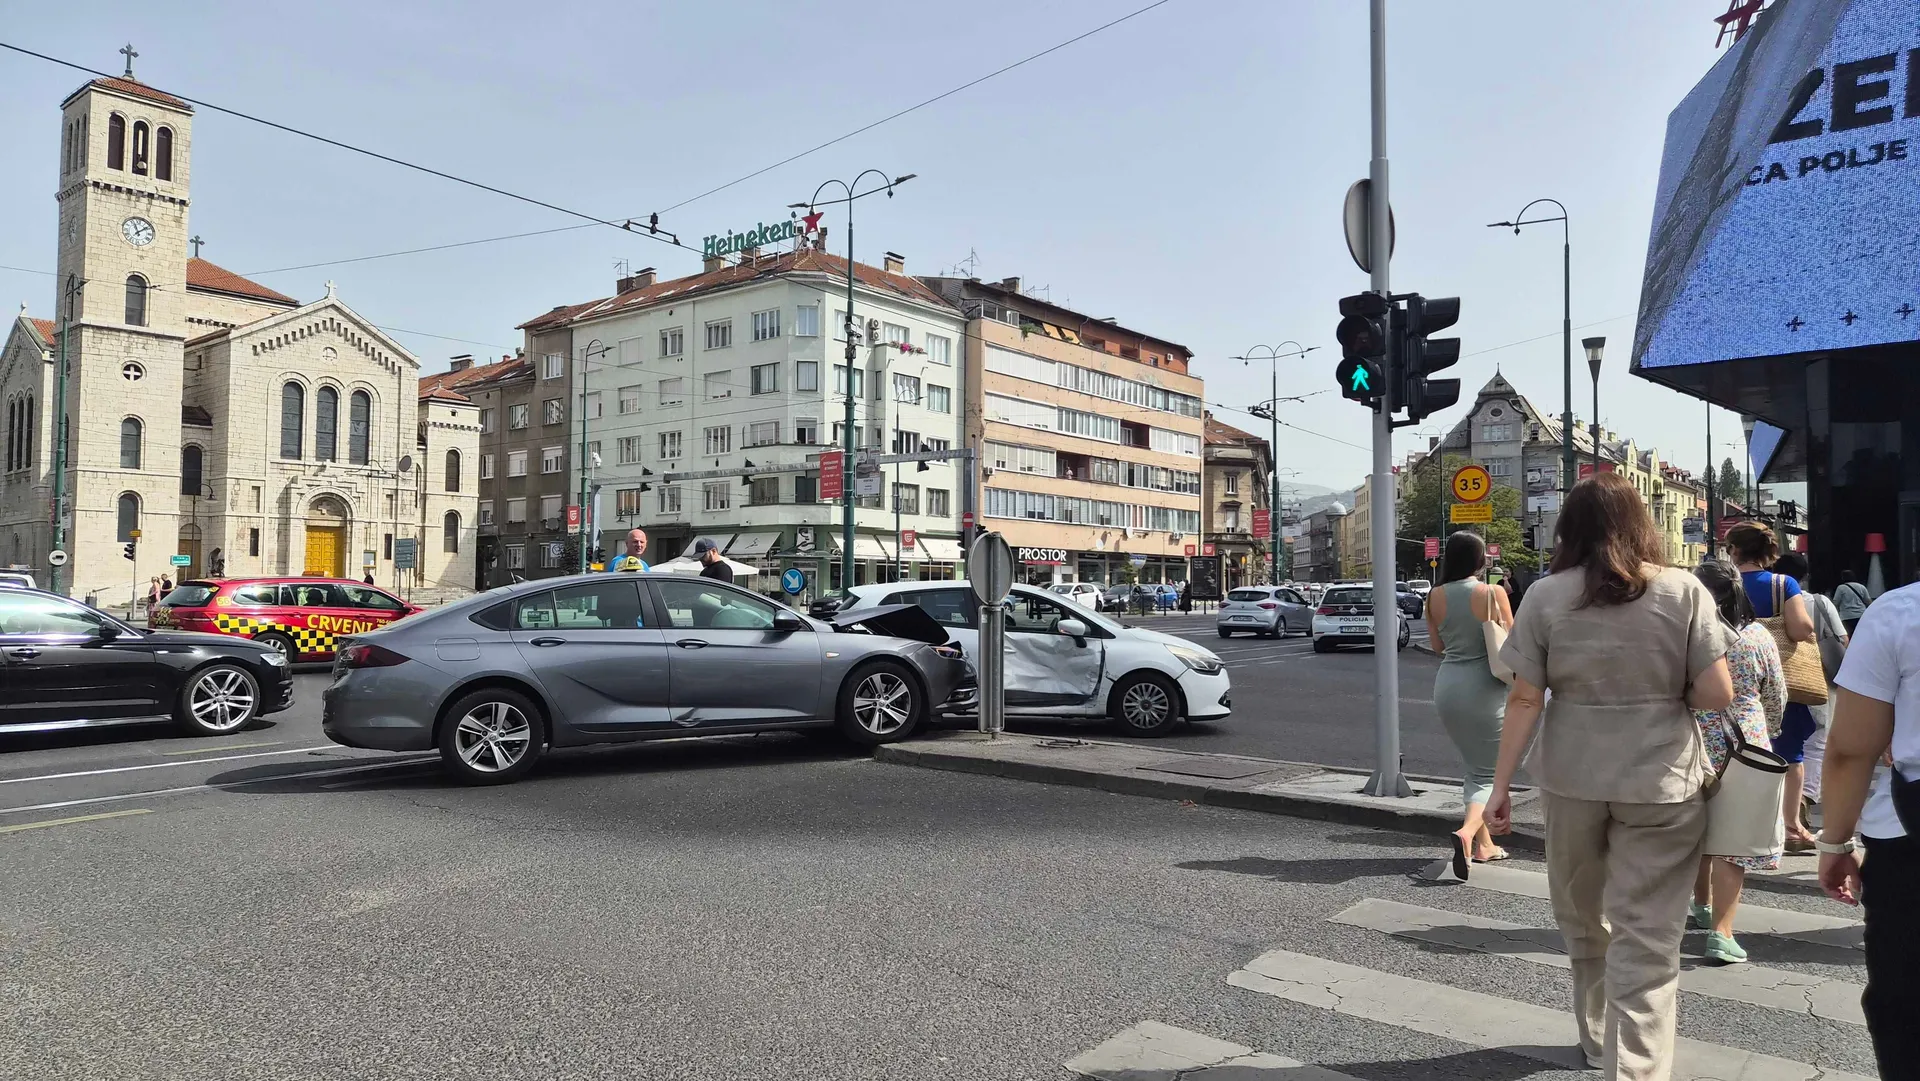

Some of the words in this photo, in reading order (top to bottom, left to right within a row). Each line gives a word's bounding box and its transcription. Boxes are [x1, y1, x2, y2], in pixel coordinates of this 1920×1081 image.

[1798, 139, 1908, 177] POLJE
[702, 219, 795, 261] Heineken
[1018, 547, 1067, 562] PROSTOR
[307, 613, 373, 635] CRVENI
